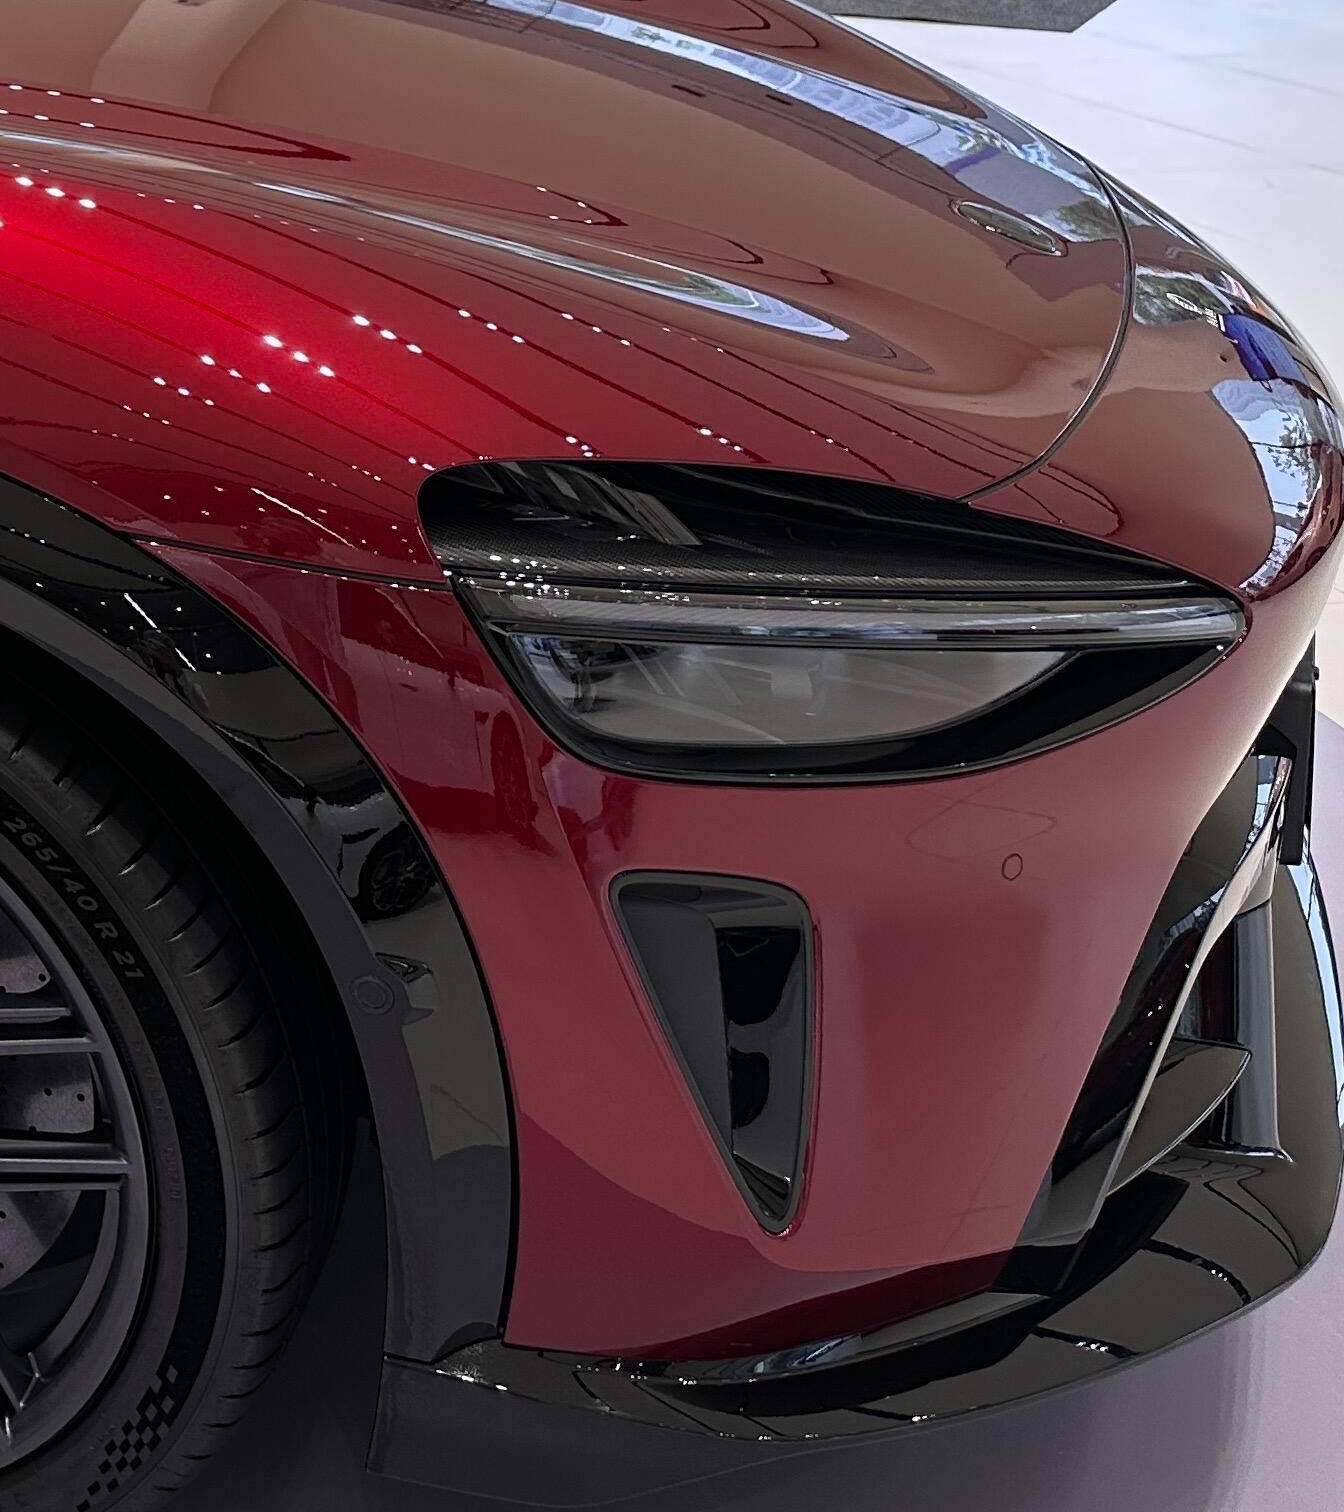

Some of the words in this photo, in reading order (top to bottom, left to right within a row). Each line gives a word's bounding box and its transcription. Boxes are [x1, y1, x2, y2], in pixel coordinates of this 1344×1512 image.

[1, 814, 101, 915] 265/40
[91, 919, 120, 943] R
[110, 949, 146, 981] 21
